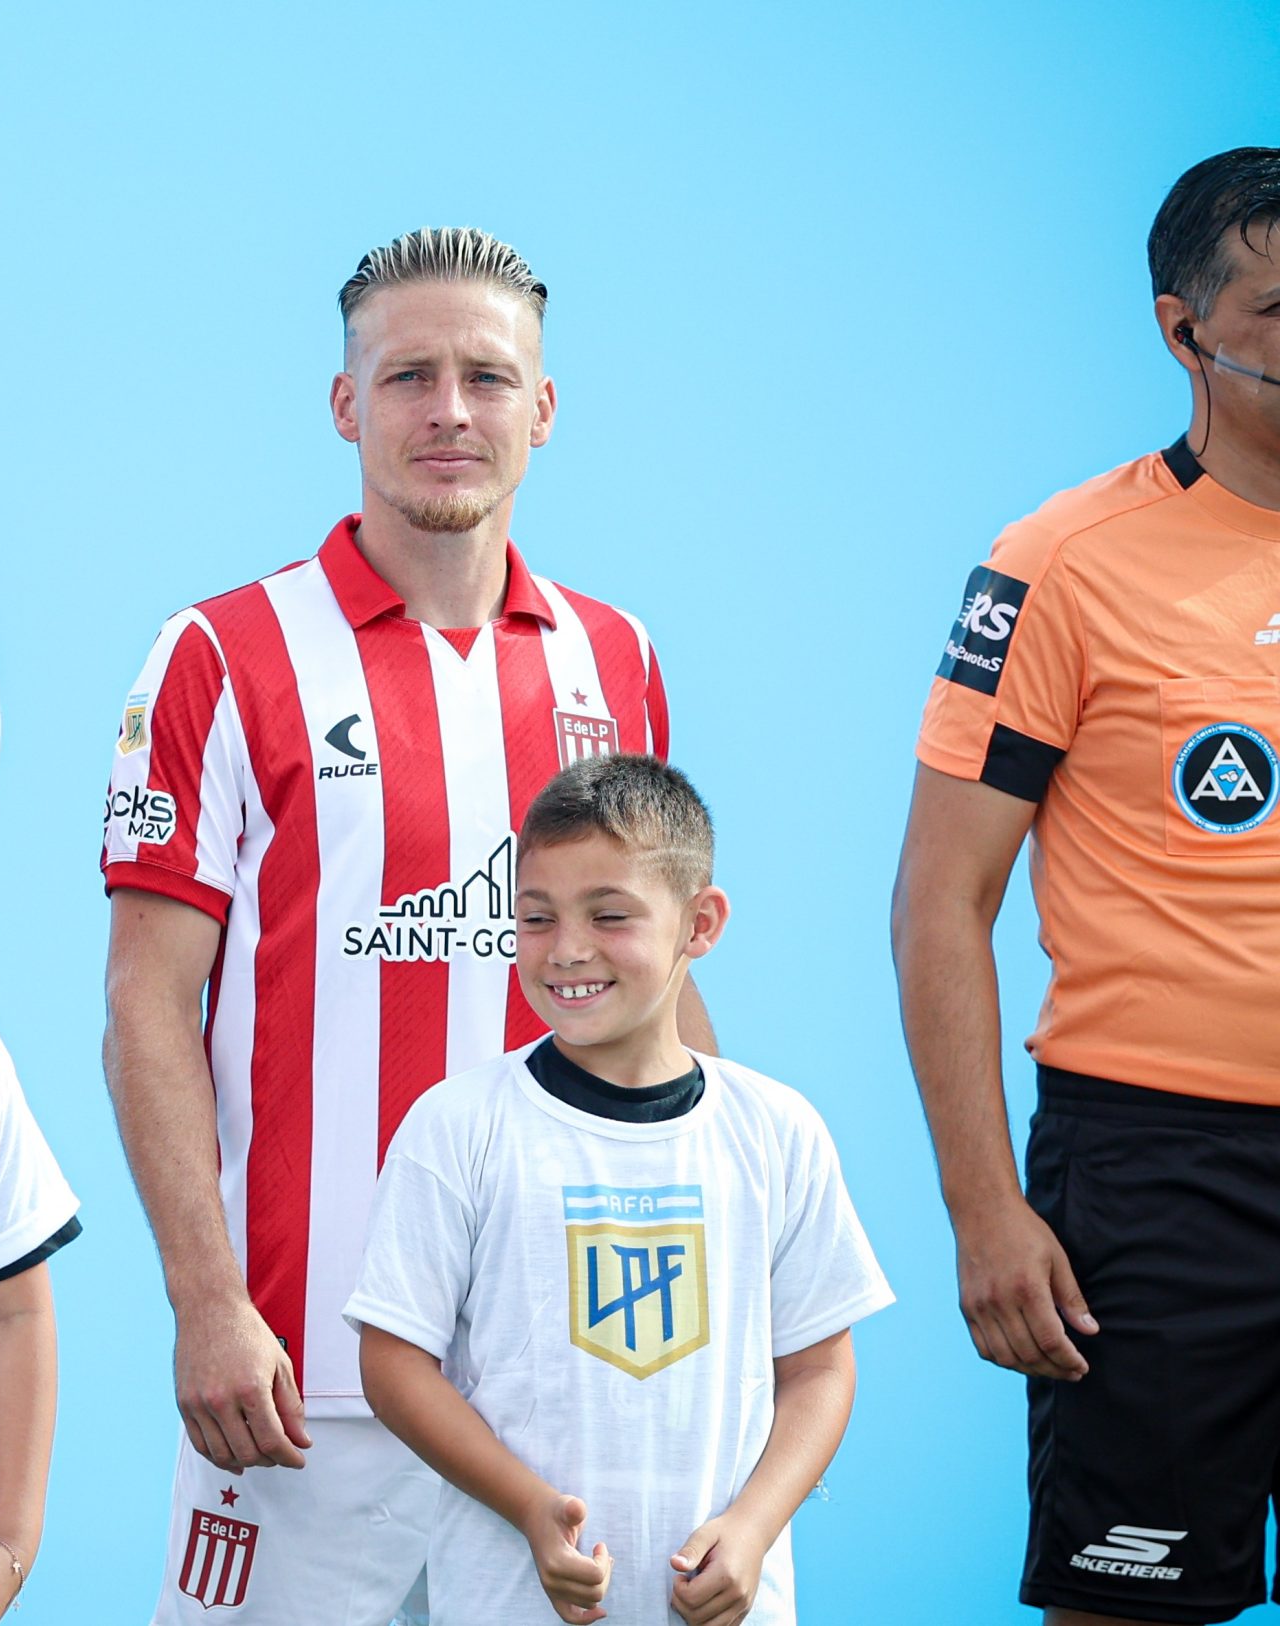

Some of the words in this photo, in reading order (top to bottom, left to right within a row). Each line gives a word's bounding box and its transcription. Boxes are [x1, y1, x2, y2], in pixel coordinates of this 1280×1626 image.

[962, 591, 1019, 641] RS
[563, 717, 609, 738] EdeLP
[318, 763, 379, 780] RUGE
[128, 820, 172, 841] M2V
[608, 1194, 655, 1215] AFA
[586, 1243, 686, 1353] LPF
[198, 1515, 251, 1542] EdeLP
[1069, 1553, 1184, 1581] SKECHERS
